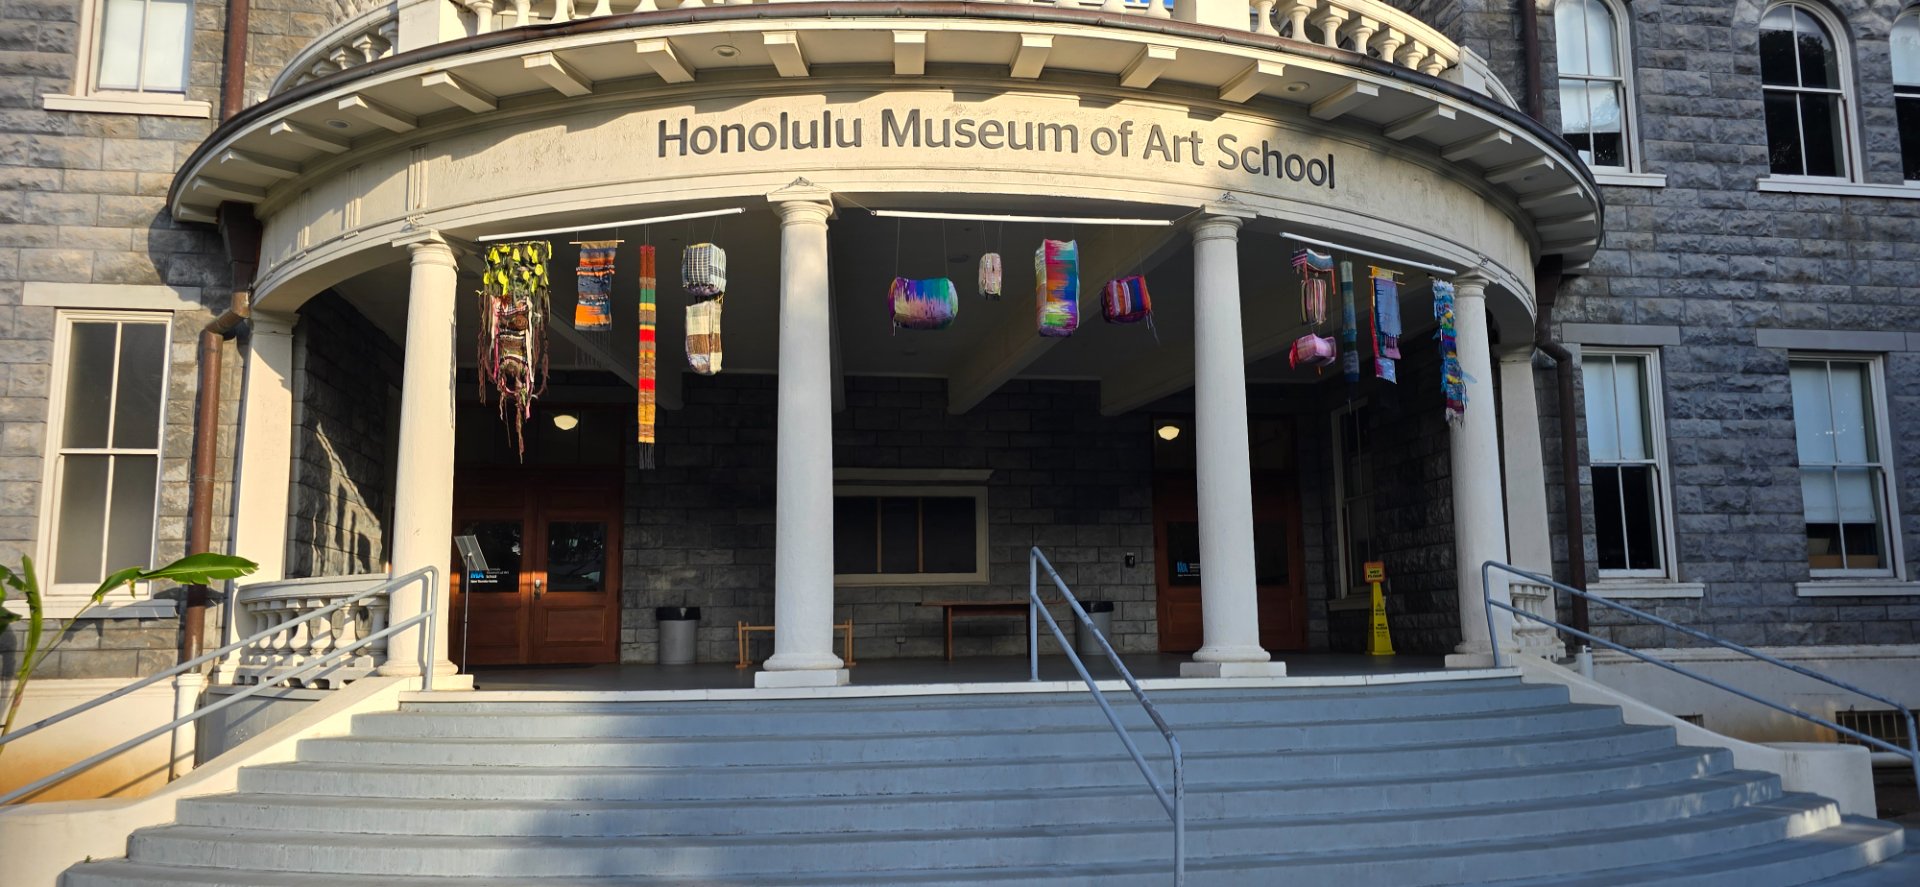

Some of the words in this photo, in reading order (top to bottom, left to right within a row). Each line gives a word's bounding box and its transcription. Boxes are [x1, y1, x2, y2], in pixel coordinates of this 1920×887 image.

[658, 110, 862, 158] Honolulu
[881, 108, 1079, 153] Museum
[1089, 120, 1133, 157] of
[1143, 125, 1205, 166] Art
[1218, 133, 1336, 189] School
